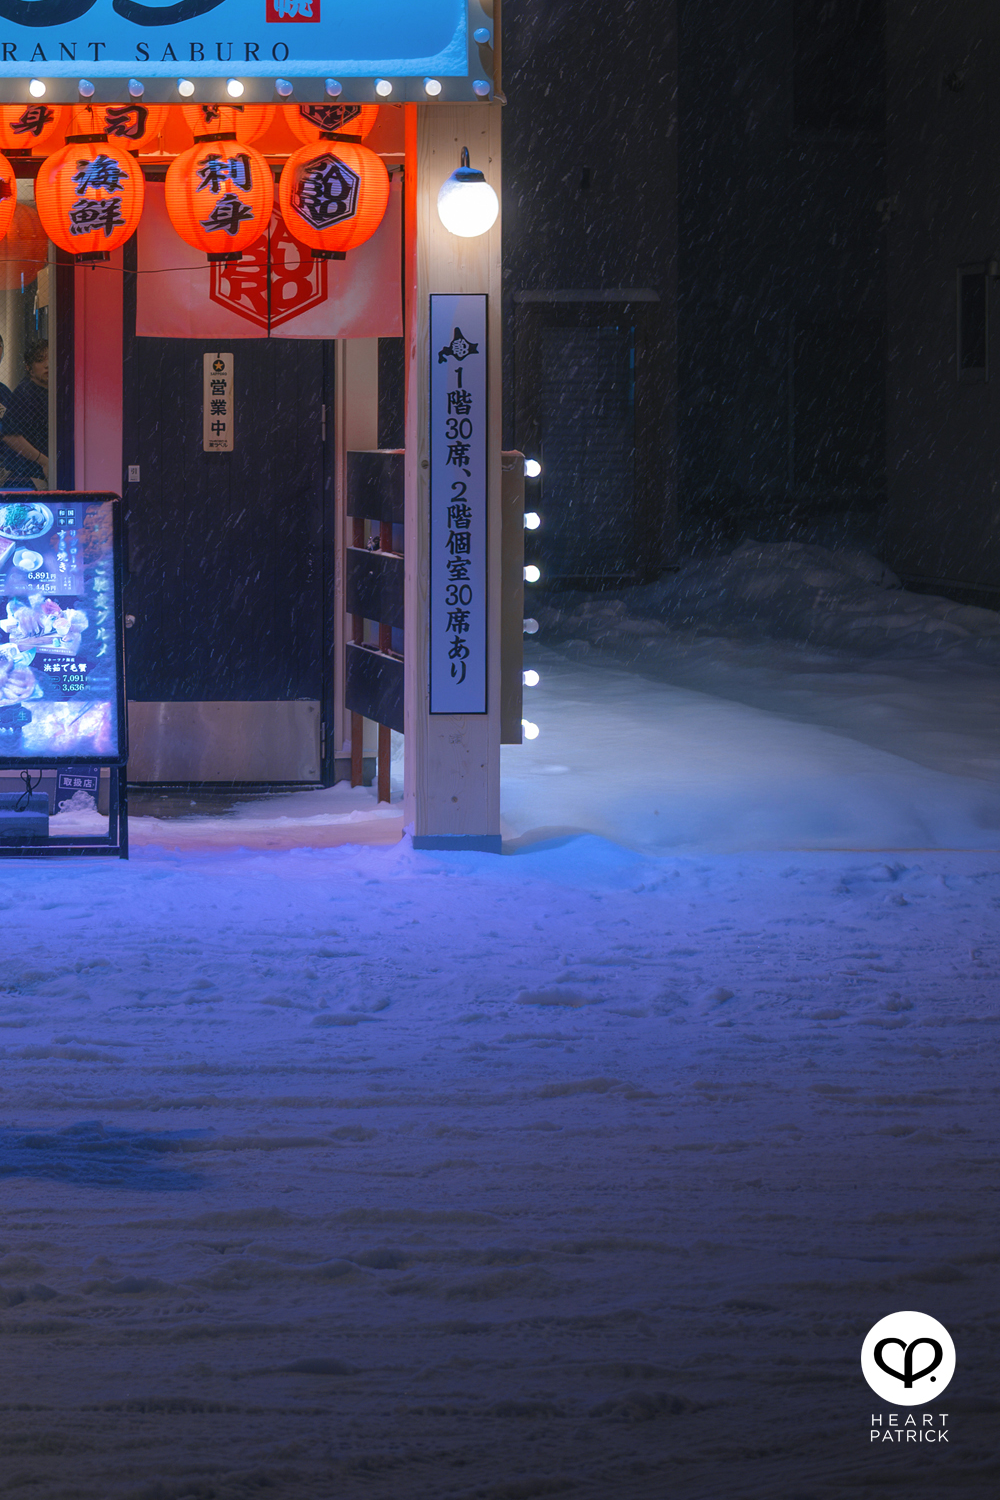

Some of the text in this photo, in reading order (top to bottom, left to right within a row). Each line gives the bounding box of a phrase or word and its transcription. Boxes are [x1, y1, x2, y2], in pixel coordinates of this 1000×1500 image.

[135, 42, 290, 62] SABURO
[69, 154, 129, 238] 海鮮
[196, 152, 255, 236] 刺身
[210, 378, 228, 437] 営業中
